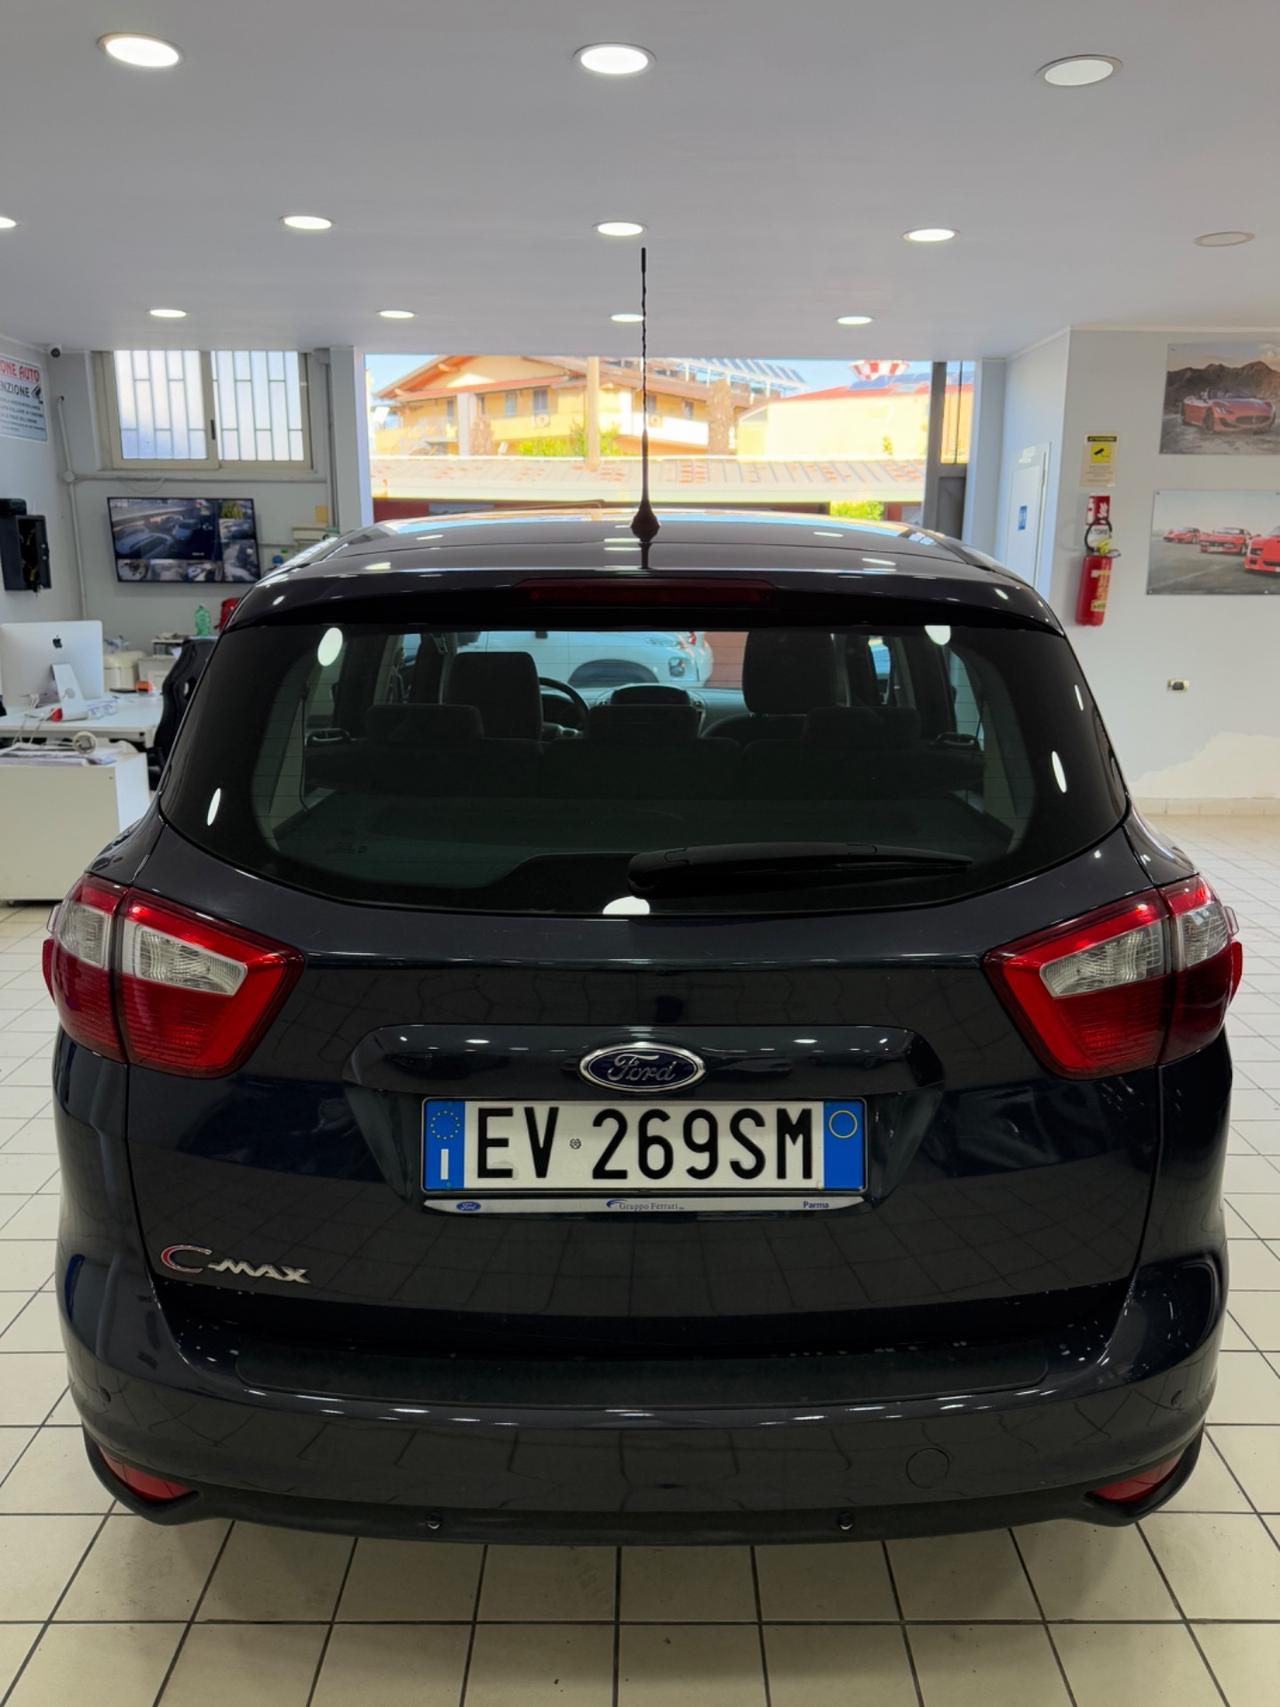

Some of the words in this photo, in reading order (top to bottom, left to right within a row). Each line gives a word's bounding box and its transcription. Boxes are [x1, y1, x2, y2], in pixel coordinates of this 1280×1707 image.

[19, 366, 40, 383] AUTO
[608, 1053, 678, 1081] Ford
[477, 1107, 559, 1178] EV
[592, 1107, 813, 1179] 269SM
[619, 1202, 649, 1212] Gruppo
[650, 1202, 678, 1210] Ferrari
[803, 1200, 829, 1209] Parma
